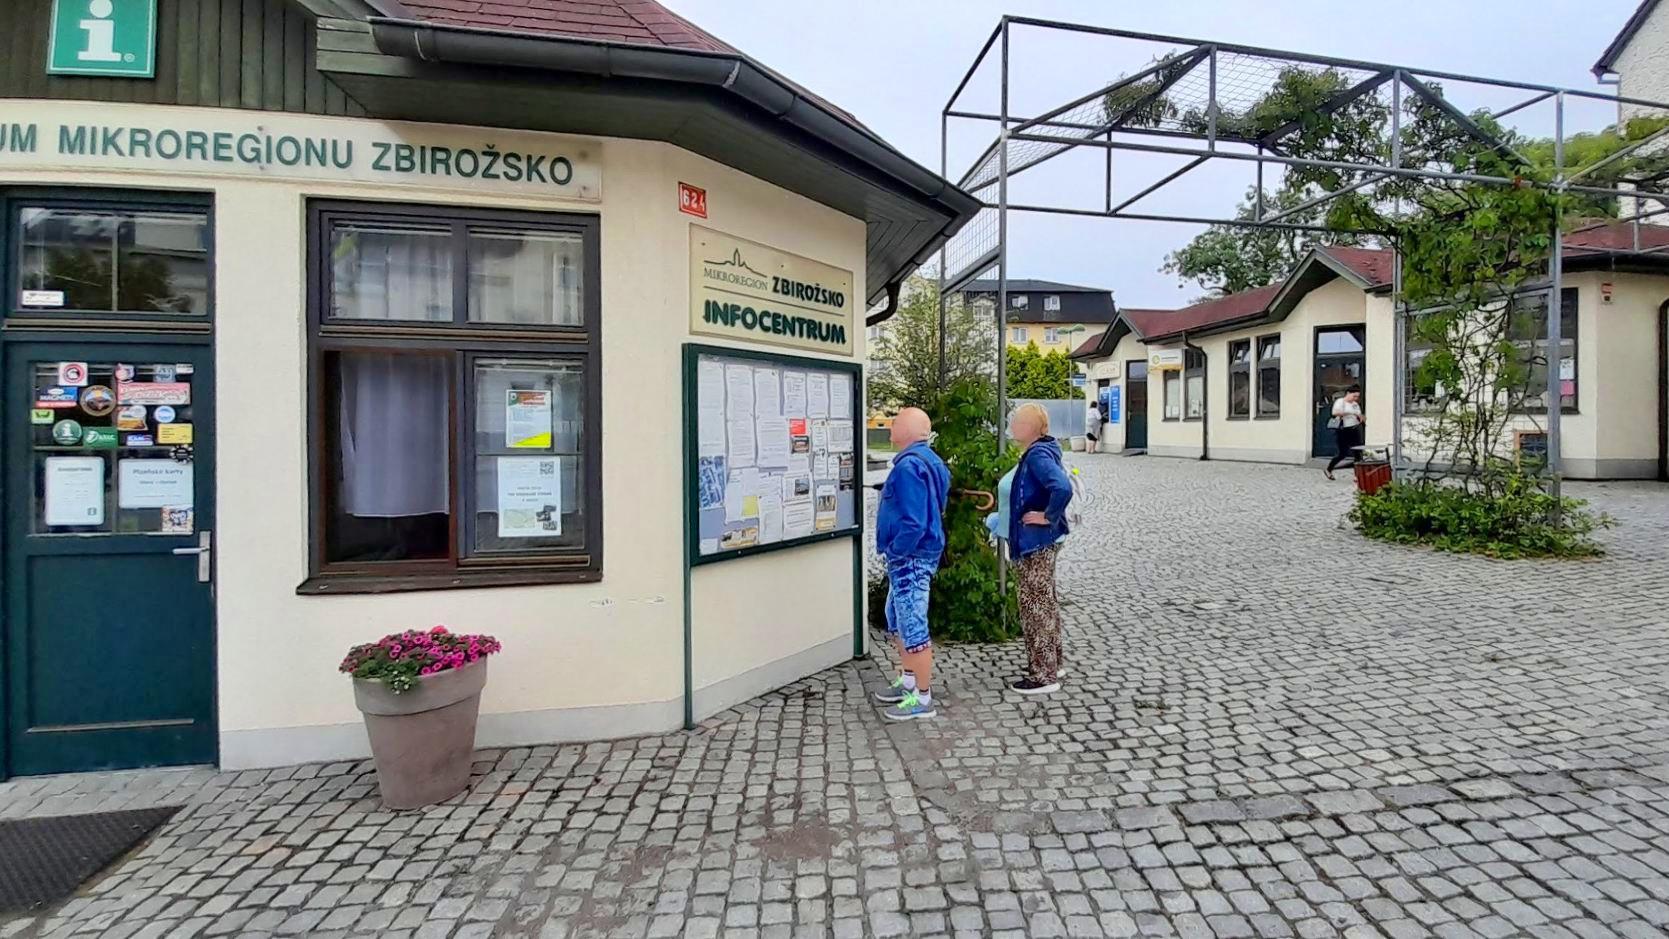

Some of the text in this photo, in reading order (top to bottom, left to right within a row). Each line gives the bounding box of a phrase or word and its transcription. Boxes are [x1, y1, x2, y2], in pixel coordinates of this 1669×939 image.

[58, 125, 353, 169] MIKROREGIONU
[371, 141, 574, 186] ZBIROŽSKO
[683, 189, 705, 212] 624
[703, 267, 845, 308] MIKROREGION ZBIROŽSKO
[703, 299, 847, 345] INFOCENTRUM
